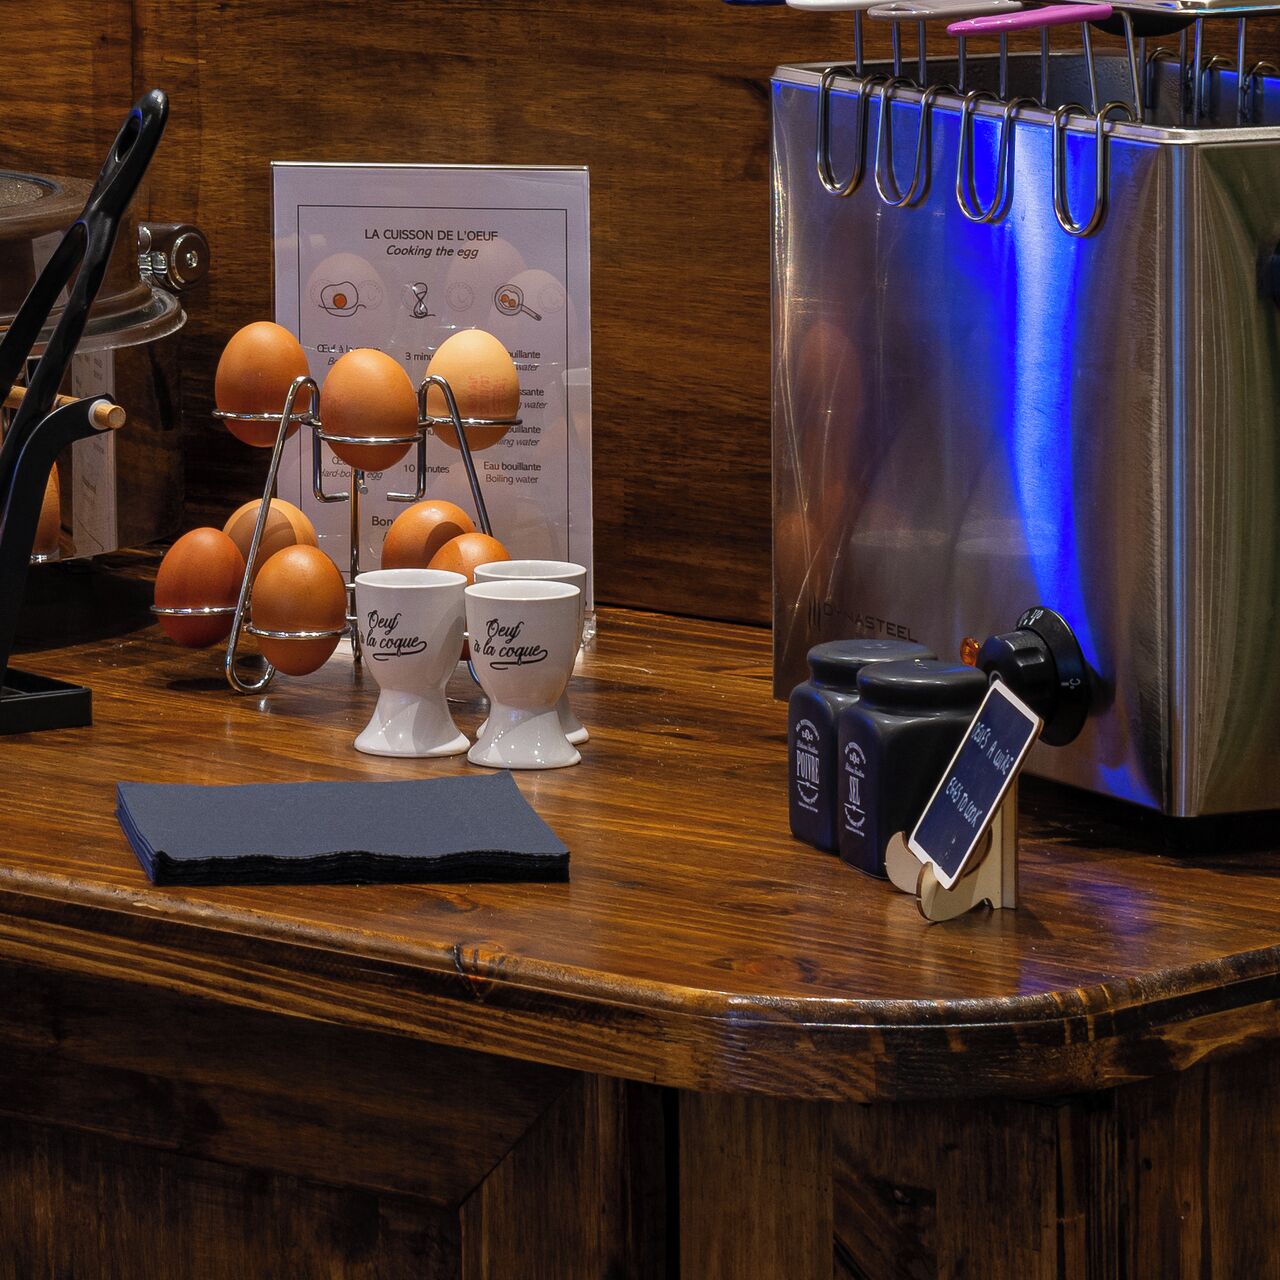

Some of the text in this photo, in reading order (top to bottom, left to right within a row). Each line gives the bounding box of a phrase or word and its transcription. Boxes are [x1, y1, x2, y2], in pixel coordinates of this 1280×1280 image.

[364, 229, 499, 241] LA CUISSON DE L'OEUF
[386, 245, 479, 259] Cooking the egg
[405, 351, 412, 361] 3
[524, 400, 548, 409] water
[515, 438, 540, 446] water
[404, 464, 450, 474] 10 inutes
[483, 461, 542, 471] Eau bouillante
[366, 471, 383, 481] egg
[485, 474, 539, 485] Boiling water
[367, 610, 402, 636] Oeuf
[486, 618, 525, 644] Oeuf
[366, 628, 378, 648] la
[378, 636, 427, 658] coque
[473, 636, 548, 666] à la coque
[796, 750, 820, 785] POIVRE
[848, 775, 861, 806] SEL
